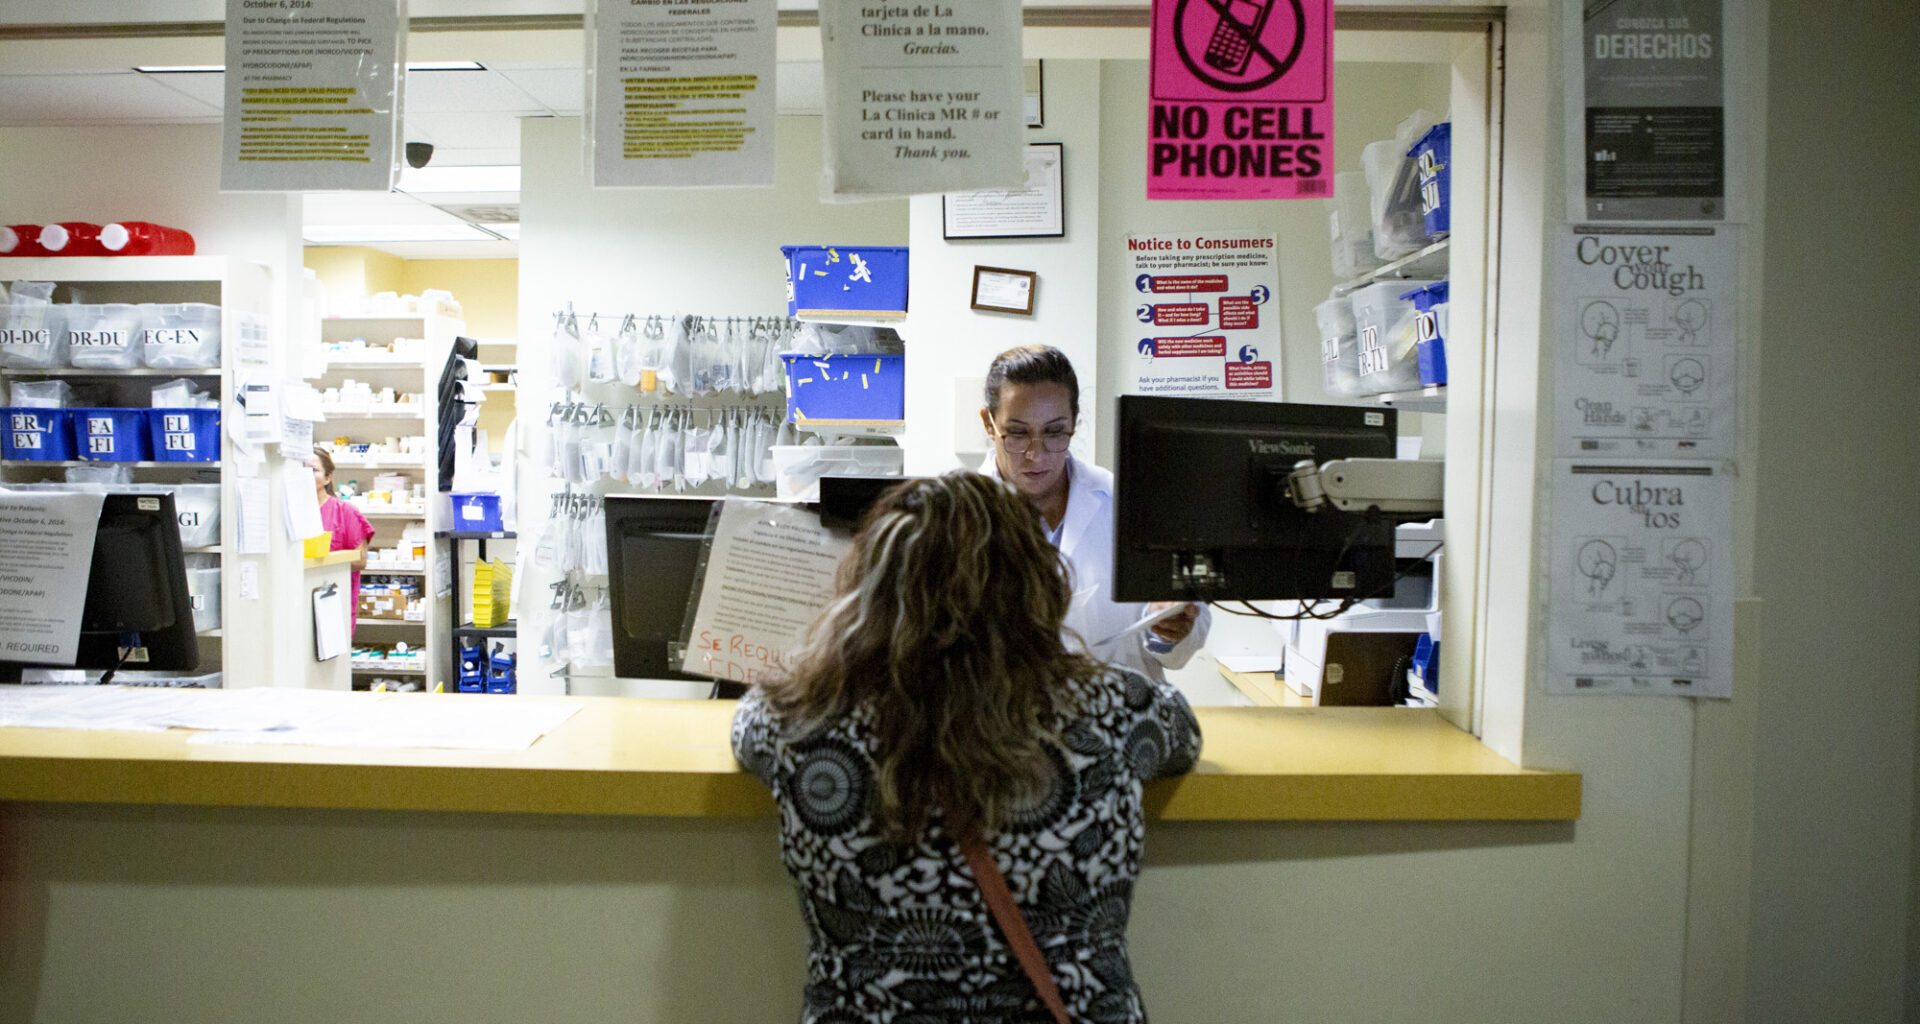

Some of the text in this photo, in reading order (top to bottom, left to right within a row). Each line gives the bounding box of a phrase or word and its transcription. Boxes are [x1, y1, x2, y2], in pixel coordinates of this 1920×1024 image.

[243, 0, 278, 9] October
[289, 0, 314, 9] 2014:
[668, 8, 711, 16] FEDERALES
[326, 16, 366, 25] Regulations
[861, 5, 953, 21] tarjeta de La
[861, 23, 990, 37] Clinica a la mano.
[903, 41, 960, 56] Gracias.
[1595, 33, 1712, 60] DERECHOS
[862, 89, 981, 105] Please have your
[861, 107, 1001, 122] La Clinica MR # or
[1153, 105, 1325, 141] NO CELL
[861, 126, 957, 140] card in hand.
[894, 145, 972, 162] Thank you.
[1153, 143, 1322, 178] PHONES
[1128, 236, 1274, 251] Notice to Consumers
[1576, 236, 1670, 266] Cover
[1158, 254, 1181, 262] taking
[1195, 253, 1235, 262] prescription
[1236, 252, 1268, 260] medicine,
[1158, 262, 1172, 270] your
[1140, 276, 1152, 293] 1
[1614, 264, 1707, 297] Cough
[1251, 285, 1266, 306] 3
[1137, 304, 1151, 320] 2
[69, 331, 125, 346] DR-DU
[144, 329, 200, 345] EC-EN
[1244, 345, 1258, 365] 5
[1166, 375, 1201, 384] pharmacist
[1155, 384, 1187, 392] additional
[1187, 384, 1220, 393] questions.
[12, 415, 37, 430] ER
[88, 419, 111, 434] FA
[166, 416, 189, 431] FL
[1248, 438, 1316, 456] ViewSonic
[1592, 479, 1685, 506] Cubra
[178, 511, 199, 527] GI
[1644, 509, 1680, 529] tos
[6, 641, 60, 655] REQUIRED
